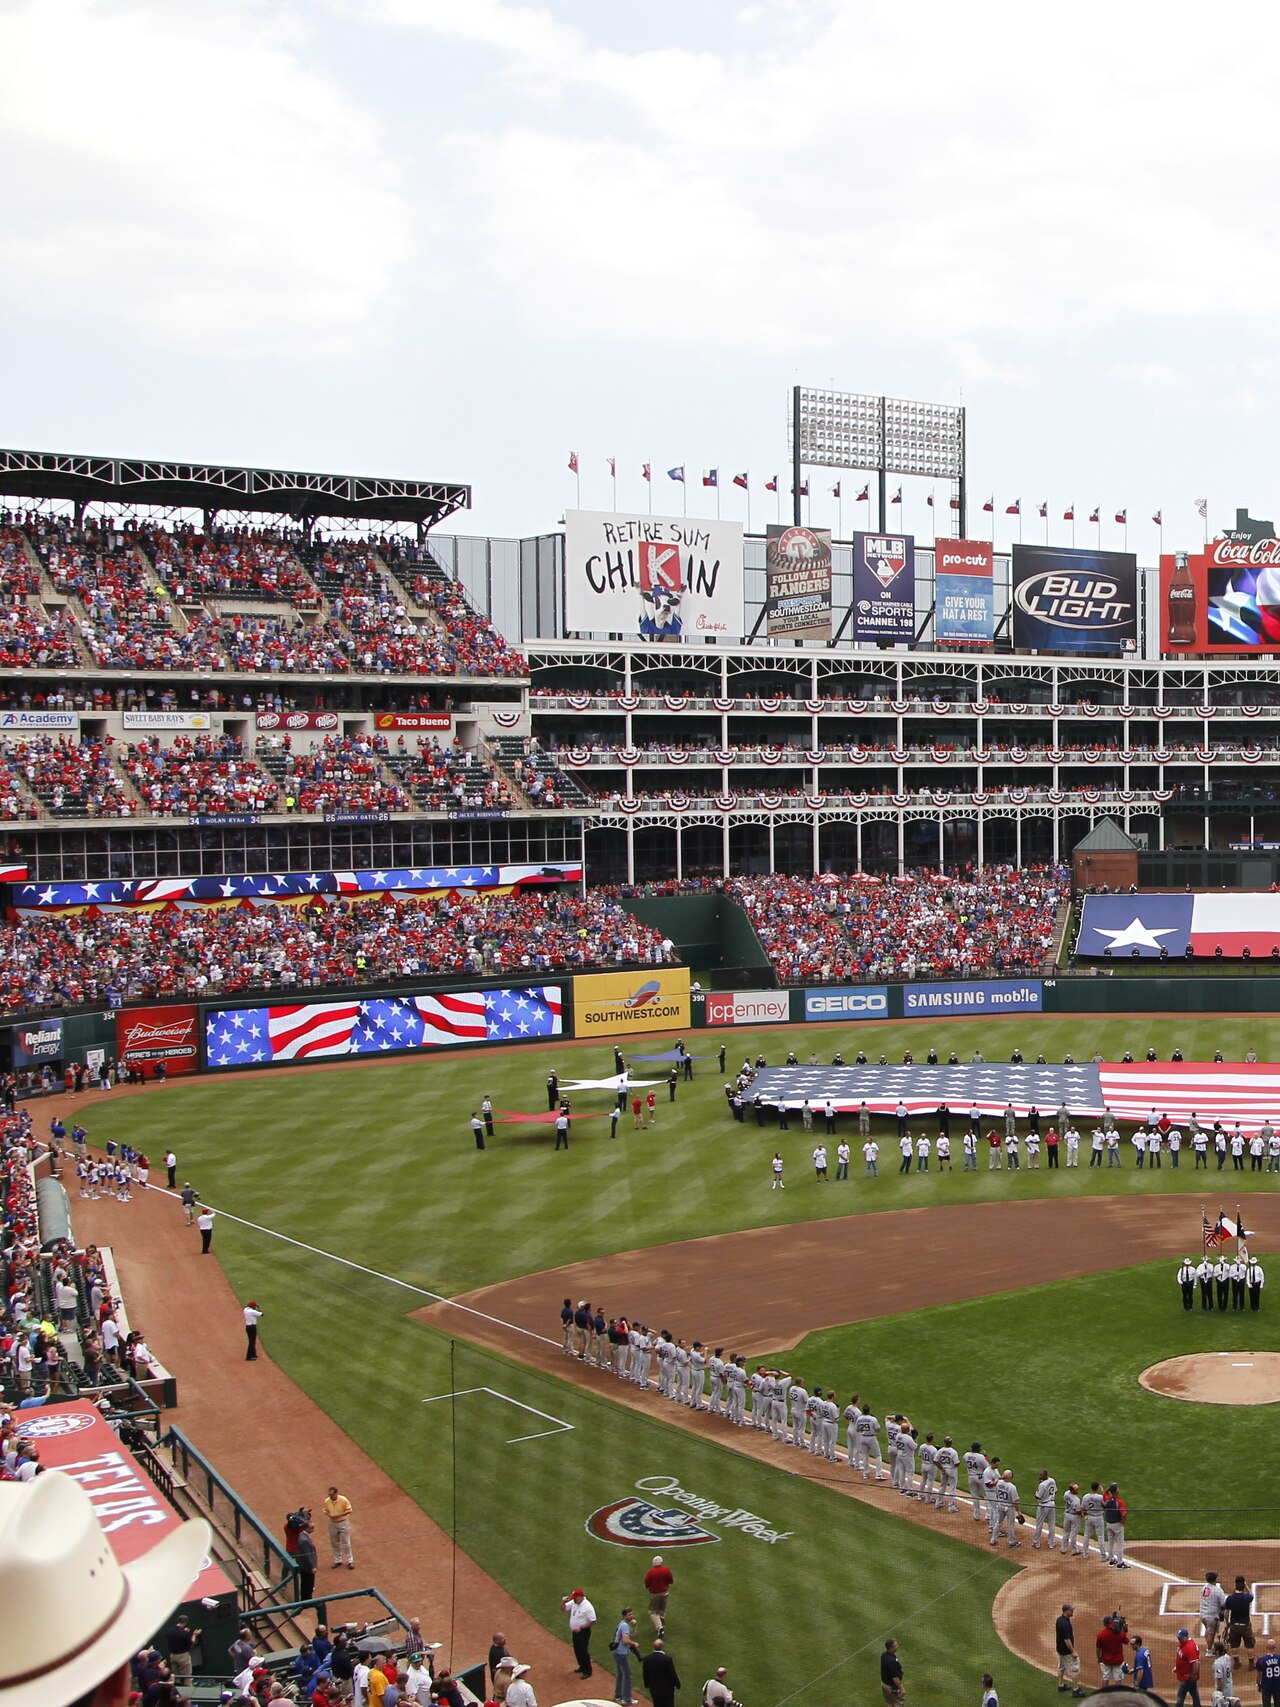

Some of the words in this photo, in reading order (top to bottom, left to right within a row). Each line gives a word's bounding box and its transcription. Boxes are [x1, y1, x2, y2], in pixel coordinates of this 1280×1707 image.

[603, 520, 663, 544] RETIRE
[670, 524, 710, 550] SUM
[783, 530, 813, 544] TEXAS
[1230, 532, 1252, 541] Enjoy
[867, 538, 904, 554] MLB
[586, 544, 720, 598] CHIKIN
[772, 571, 810, 584] FOLLOW
[812, 568, 828, 578] THE
[770, 579, 830, 598] RANGERS
[1042, 576, 1118, 599] BUD
[1170, 588, 1193, 599] Coca-Cola
[945, 596, 964, 607] GIVE
[964, 598, 986, 610] YOUR
[1028, 596, 1131, 621] LIGHT
[770, 602, 830, 618] SOUTHWEST.COM
[872, 606, 914, 616] SPORTS
[942, 608, 958, 620] HAT
[958, 610, 966, 620] A
[968, 610, 988, 621] REST
[770, 622, 793, 632] SPORTS
[794, 618, 831, 628] CONNECTION
[782, 616, 800, 624] YOUR
[800, 614, 819, 622] LOCAL
[857, 616, 898, 626] CHANNEL
[900, 618, 914, 627] 198
[20, 714, 73, 726] Academy
[126, 714, 148, 723] SWEET
[149, 714, 166, 722] BABY
[167, 714, 184, 723] RAY'S
[396, 716, 418, 726] Taco
[420, 717, 450, 726] Bueno
[250, 816, 260, 824] 34
[326, 814, 336, 822] 26
[501, 810, 510, 818] 42
[1044, 980, 1056, 988] 404
[692, 994, 706, 1002] 390
[806, 994, 888, 1012] GEICO
[908, 991, 985, 1008] SAMSUNG
[103, 1011, 115, 1020] 354
[585, 1006, 680, 1024] SOUTHWEST.COM
[708, 1002, 787, 1022] jcpenney
[25, 1028, 61, 1046] Reliant
[124, 1026, 193, 1040] Budweiser
[33, 1042, 60, 1055] Energy
[126, 1051, 151, 1059] HERE'S
[165, 1047, 193, 1056] HEROES
[966, 1460, 978, 1469] 34
[634, 1476, 732, 1520] Opening
[716, 1508, 795, 1544] Week
[1266, 1666, 1280, 1678] 89
